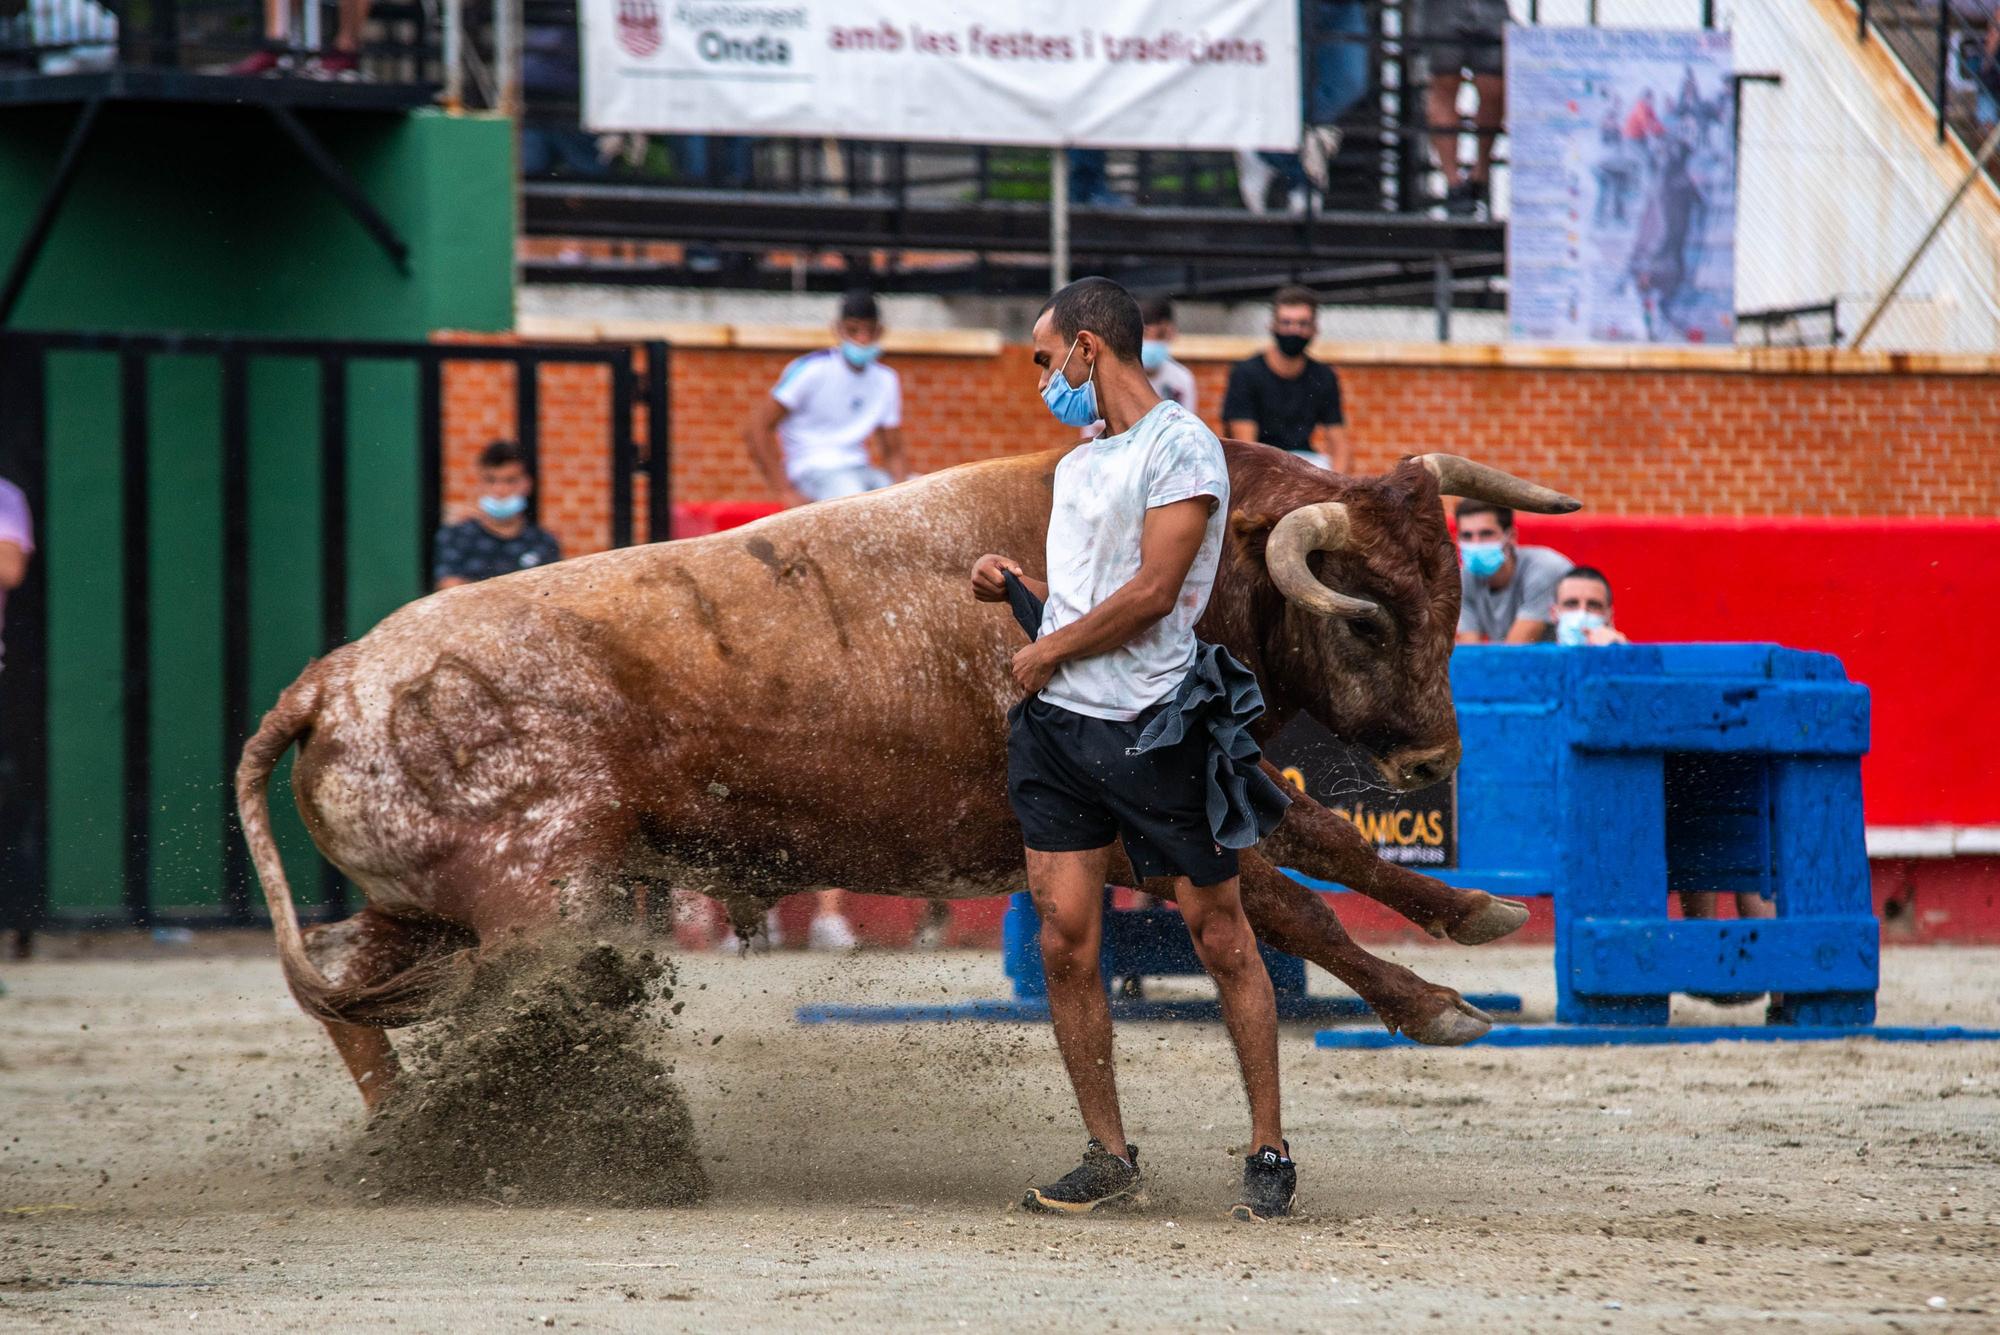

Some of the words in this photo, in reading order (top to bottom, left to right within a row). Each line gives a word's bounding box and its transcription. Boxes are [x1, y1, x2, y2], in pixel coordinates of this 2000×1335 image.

[697, 30, 791, 65] Onda
[828, 21, 903, 52] amb
[911, 25, 958, 55] les
[968, 25, 1074, 61] festes
[1082, 29, 1094, 61] i
[1103, 32, 1266, 66] tradicions
